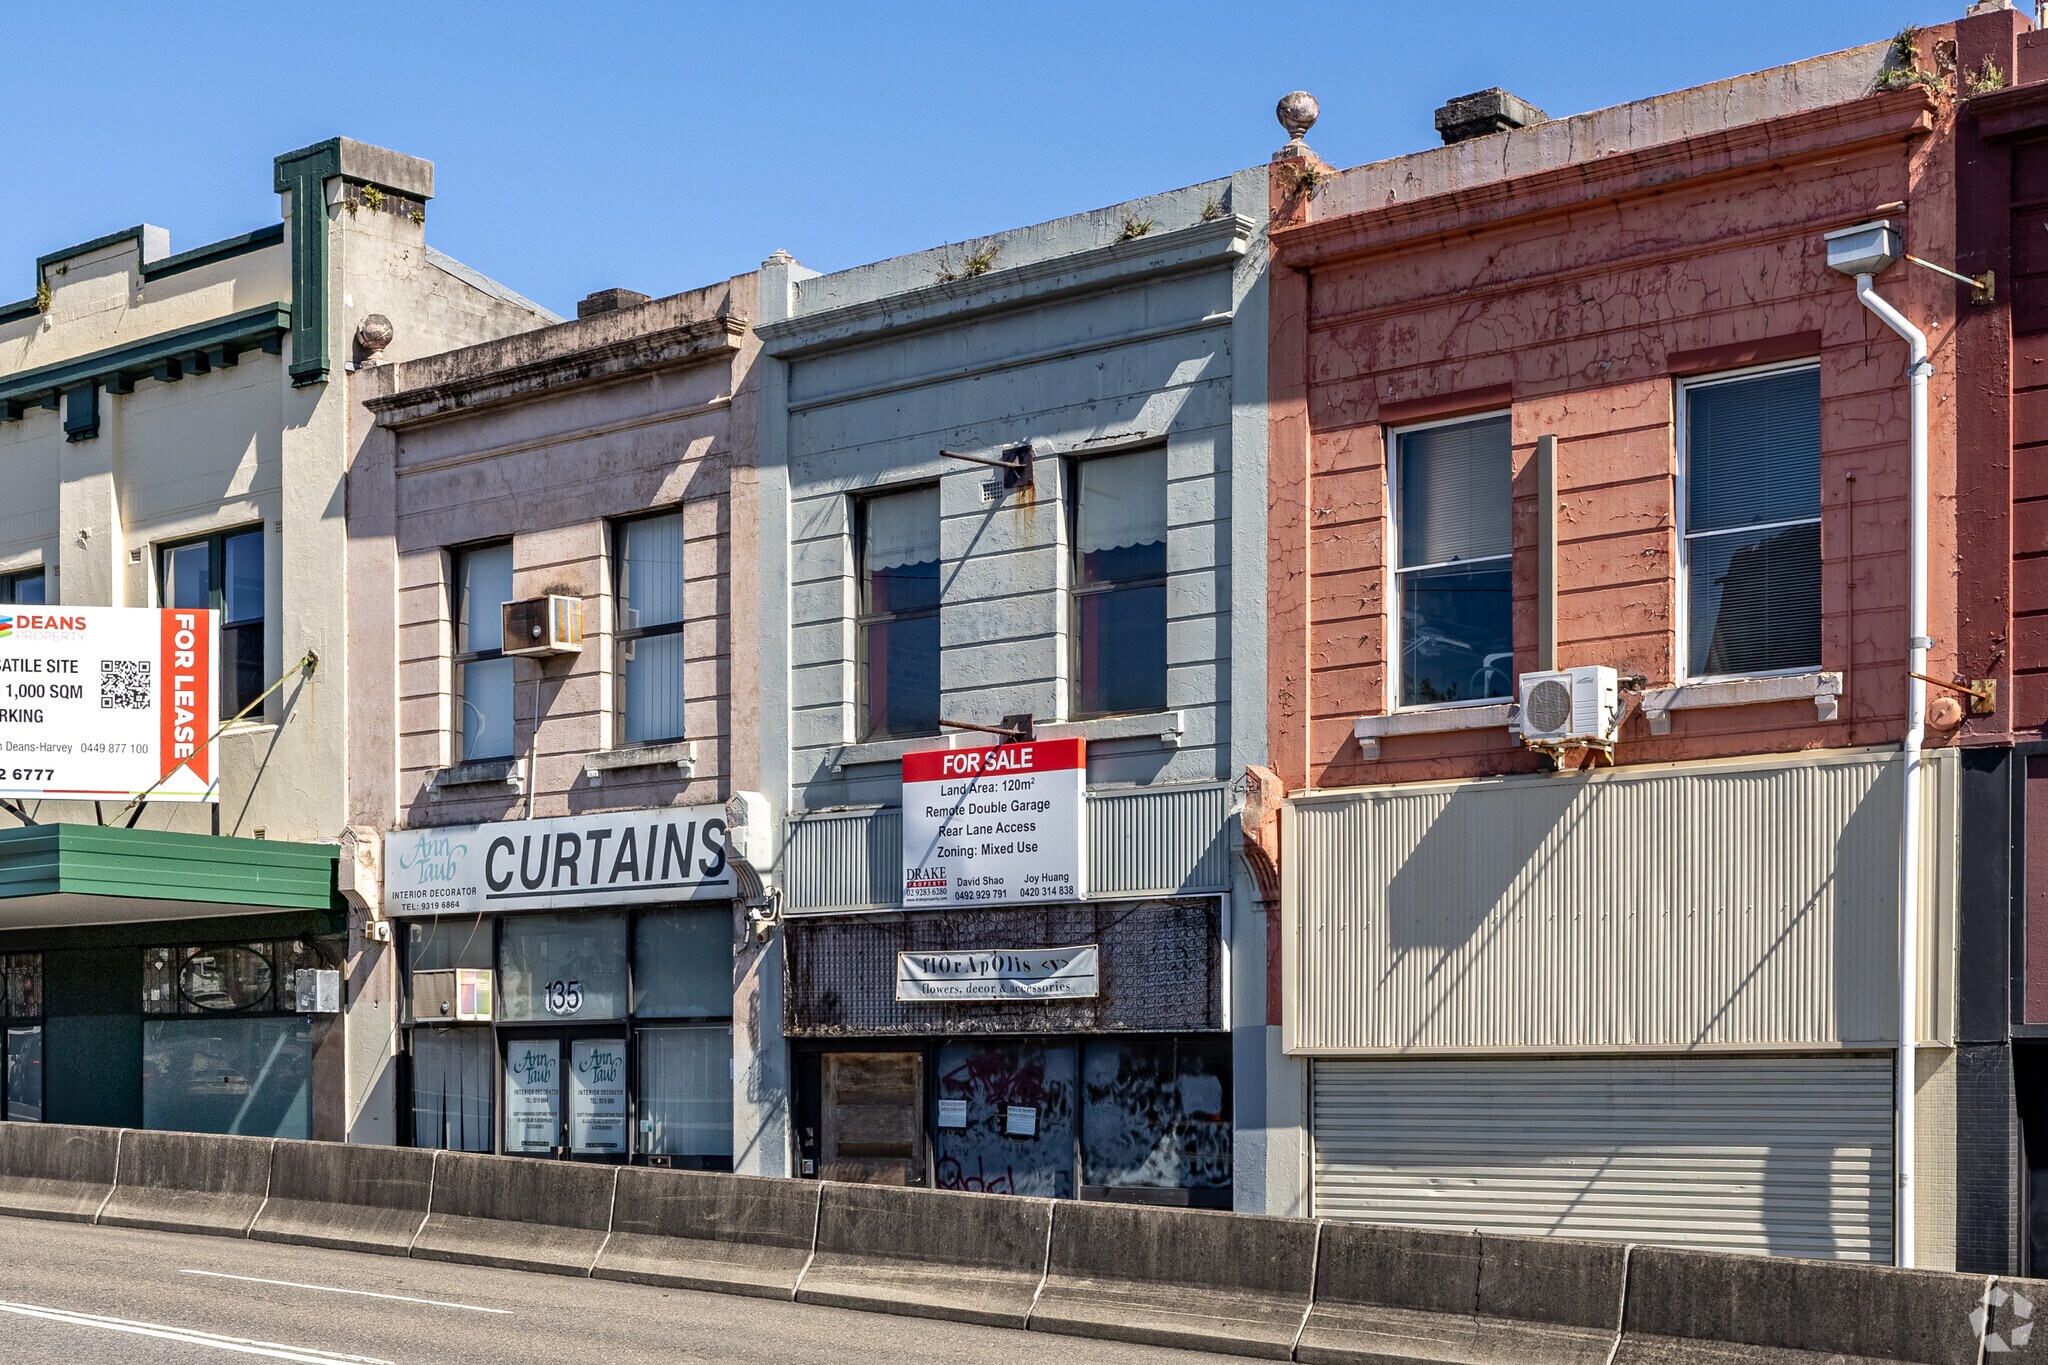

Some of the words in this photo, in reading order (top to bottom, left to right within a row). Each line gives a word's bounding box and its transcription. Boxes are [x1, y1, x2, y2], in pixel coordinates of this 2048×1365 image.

[16, 615, 87, 631] DEANS
[16, 631, 86, 642] PROPERTY
[174, 613, 195, 668] FOR
[0, 658, 42, 673] ATILE
[46, 658, 79, 674] SITE
[5, 683, 45, 700] 1,000
[50, 684, 83, 699] SQM
[174, 675, 195, 760] LEASE
[5, 741, 73, 755] Deans-Harvey
[80, 743, 106, 754] 0449
[108, 743, 127, 754] 877
[130, 743, 149, 755] 100
[943, 753, 981, 775] FOR
[984, 747, 1033, 771] SALE
[12, 768, 55, 781] 6777
[941, 783, 966, 797] Land
[969, 781, 998, 795] Area:
[1001, 776, 1035, 792] 120m²
[926, 804, 965, 818] Remote
[969, 801, 1007, 815] Double
[1010, 799, 1051, 814] Garage
[938, 825, 963, 838] Rear
[966, 824, 993, 836] Lane
[996, 821, 1036, 834] Access
[400, 833, 450, 870] Ann
[485, 818, 727, 893] CURTAINS
[937, 845, 977, 859] Zoning:
[981, 842, 1014, 856] Mixed
[1017, 841, 1038, 853] Use
[414, 844, 468, 885] Taub
[906, 866, 947, 881] DRAKE
[957, 876, 980, 887] David
[982, 875, 1004, 886] Shao
[1024, 873, 1039, 884] Joy
[1041, 872, 1069, 884] Huang
[392, 889, 427, 900] INTERIOR
[429, 887, 477, 898] DECORATOR
[906, 888, 914, 896] 02
[915, 888, 931, 896] 9283
[932, 887, 948, 895] 6280
[955, 890, 974, 900] 0492
[975, 889, 991, 899] 929
[992, 889, 1007, 898] 791
[1020, 887, 1040, 897] 0420
[1042, 886, 1057, 896] 314
[1059, 885, 1074, 895] 838
[401, 903, 419, 911] TEL:
[421, 902, 439, 910] 9319
[441, 901, 460, 909] 6864
[965, 982, 996, 993] decor
[999, 983, 1006, 993] &
[1009, 980, 1071, 993] accessories
[544, 980, 580, 1011] 135
[513, 1049, 548, 1074] Ann
[578, 1048, 613, 1073] Ann
[524, 1058, 557, 1085] Taub
[590, 1057, 623, 1084] Taub
[535, 1088, 559, 1096] DECORATOR
